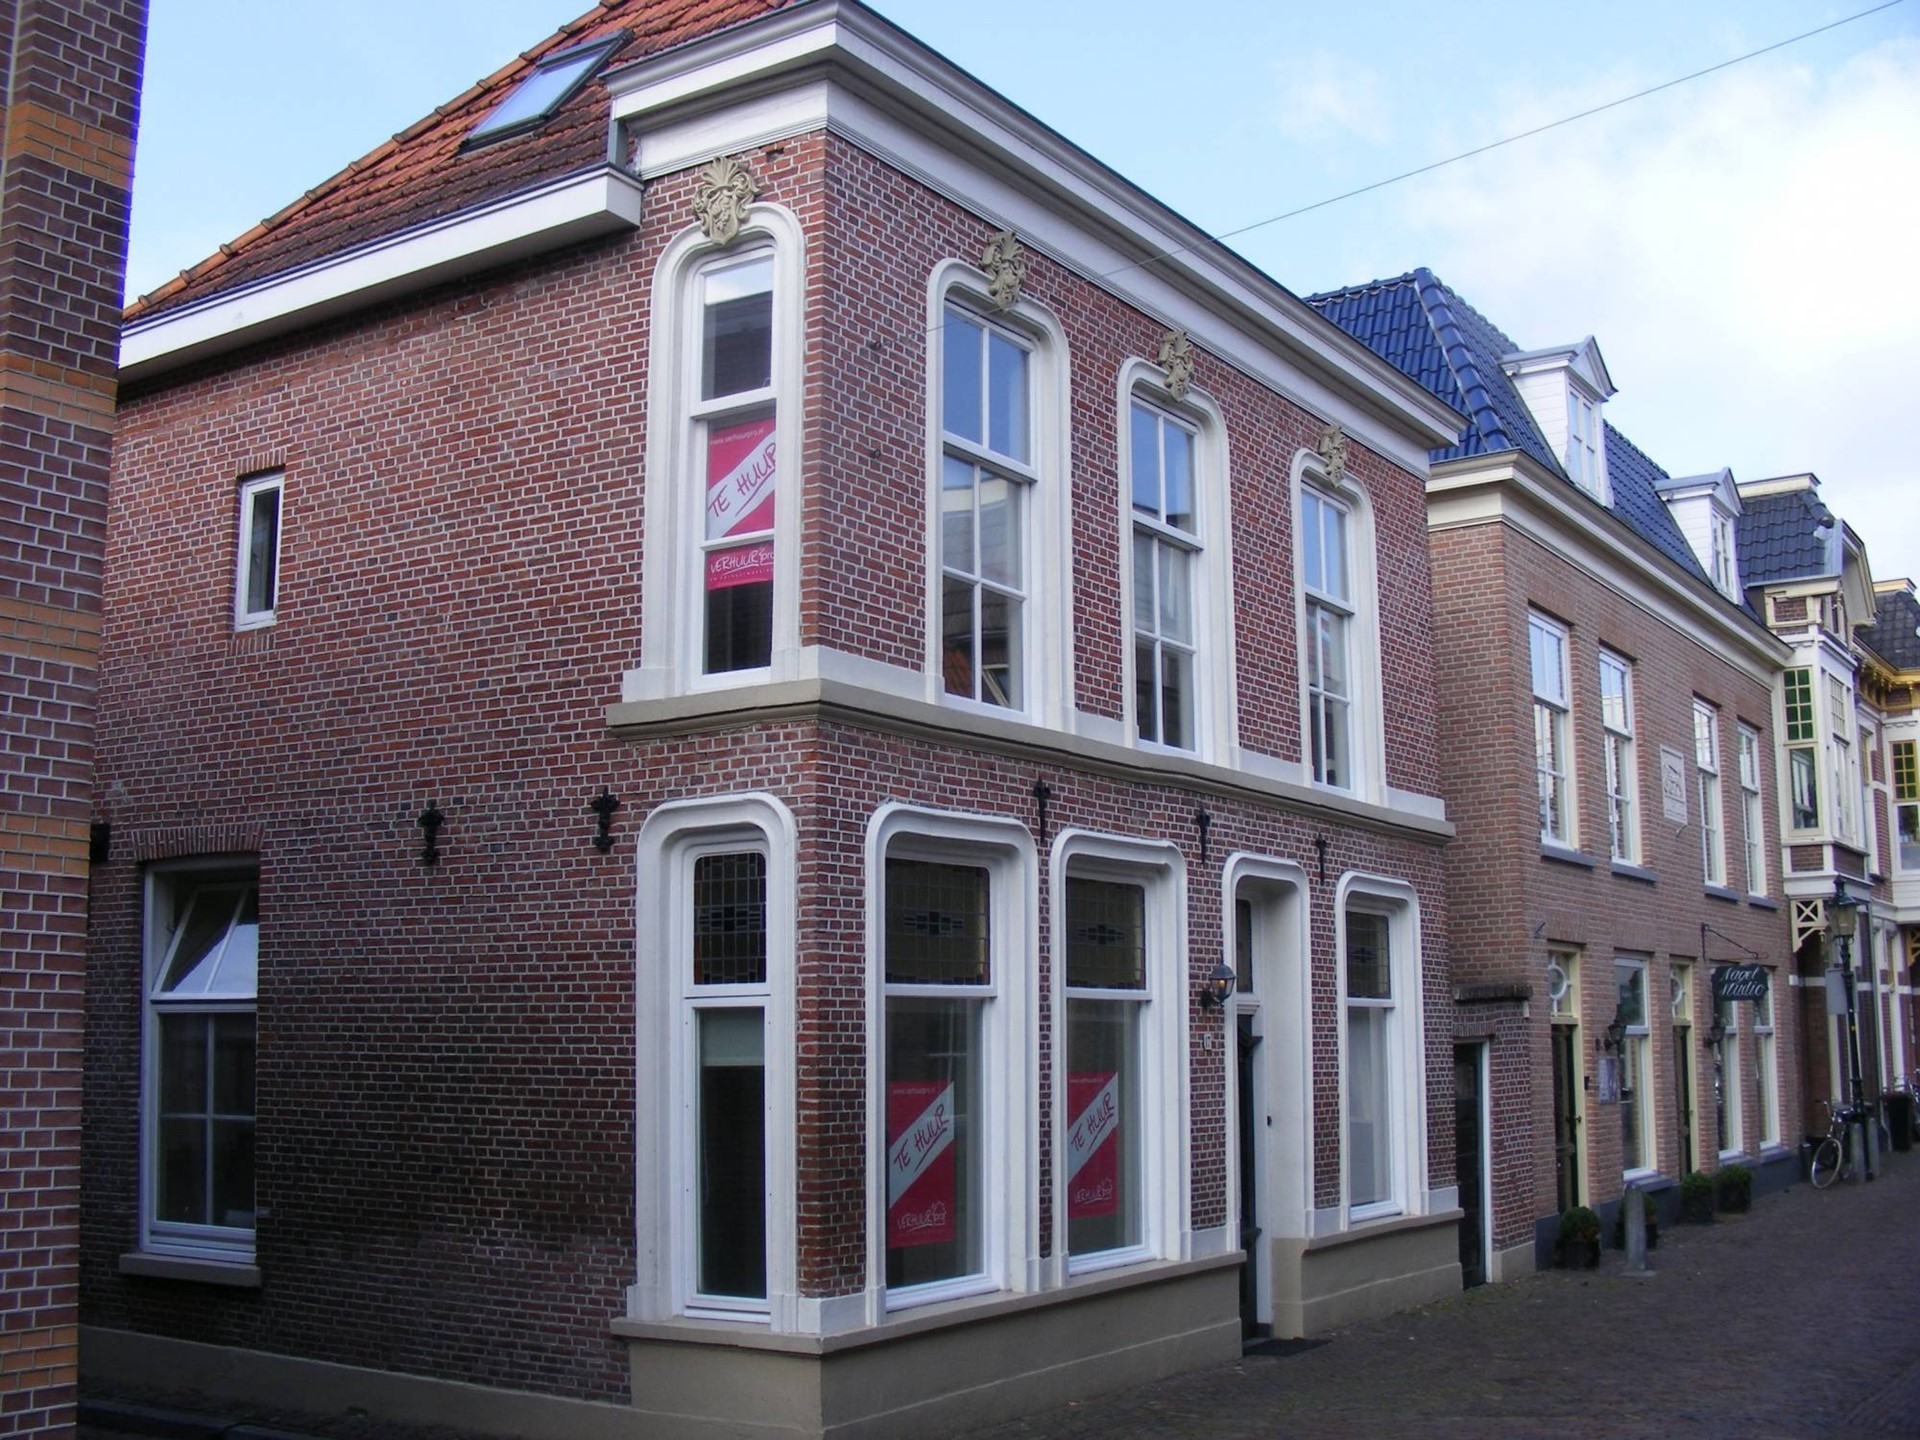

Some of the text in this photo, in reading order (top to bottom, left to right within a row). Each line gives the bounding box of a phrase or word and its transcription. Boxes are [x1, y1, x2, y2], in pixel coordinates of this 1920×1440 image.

[708, 484, 730, 517] TE
[893, 1103, 949, 1171] TE HUUR
[1071, 1123, 1085, 1151] TE
[1086, 1092, 1115, 1134] HUUR
